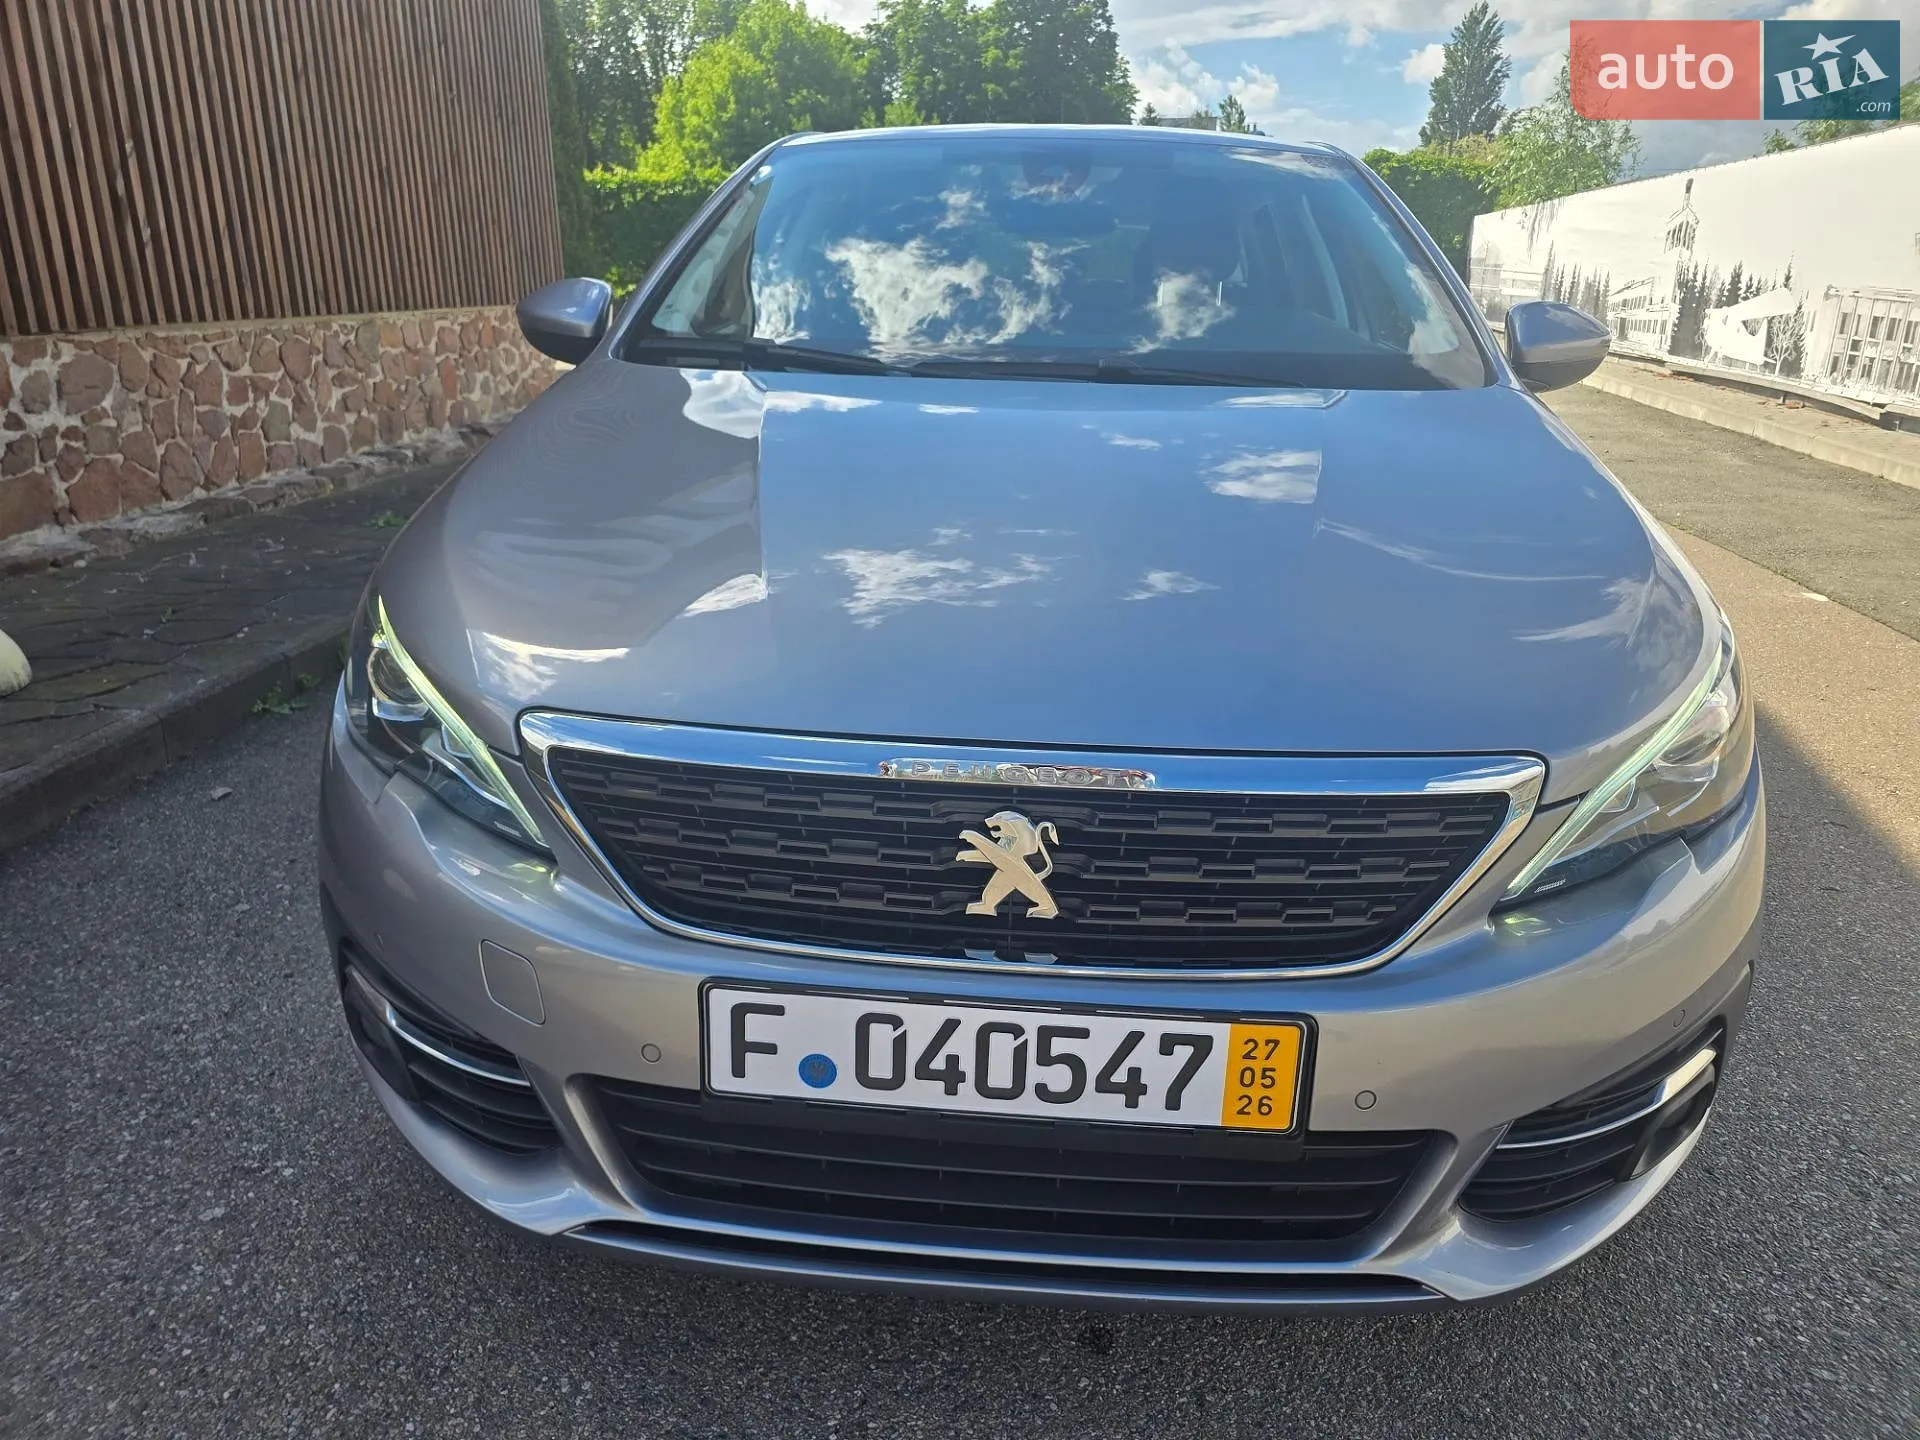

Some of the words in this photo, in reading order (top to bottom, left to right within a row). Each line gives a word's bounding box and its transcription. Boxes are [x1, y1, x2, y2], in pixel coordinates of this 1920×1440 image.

[911, 760, 1122, 786] PEUGEOT
[730, 1002, 785, 1079] F
[855, 1012, 1214, 1111] 040547
[1242, 1038, 1279, 1060] 27
[1238, 1066, 1276, 1089] 05
[1236, 1094, 1273, 1116] 26
